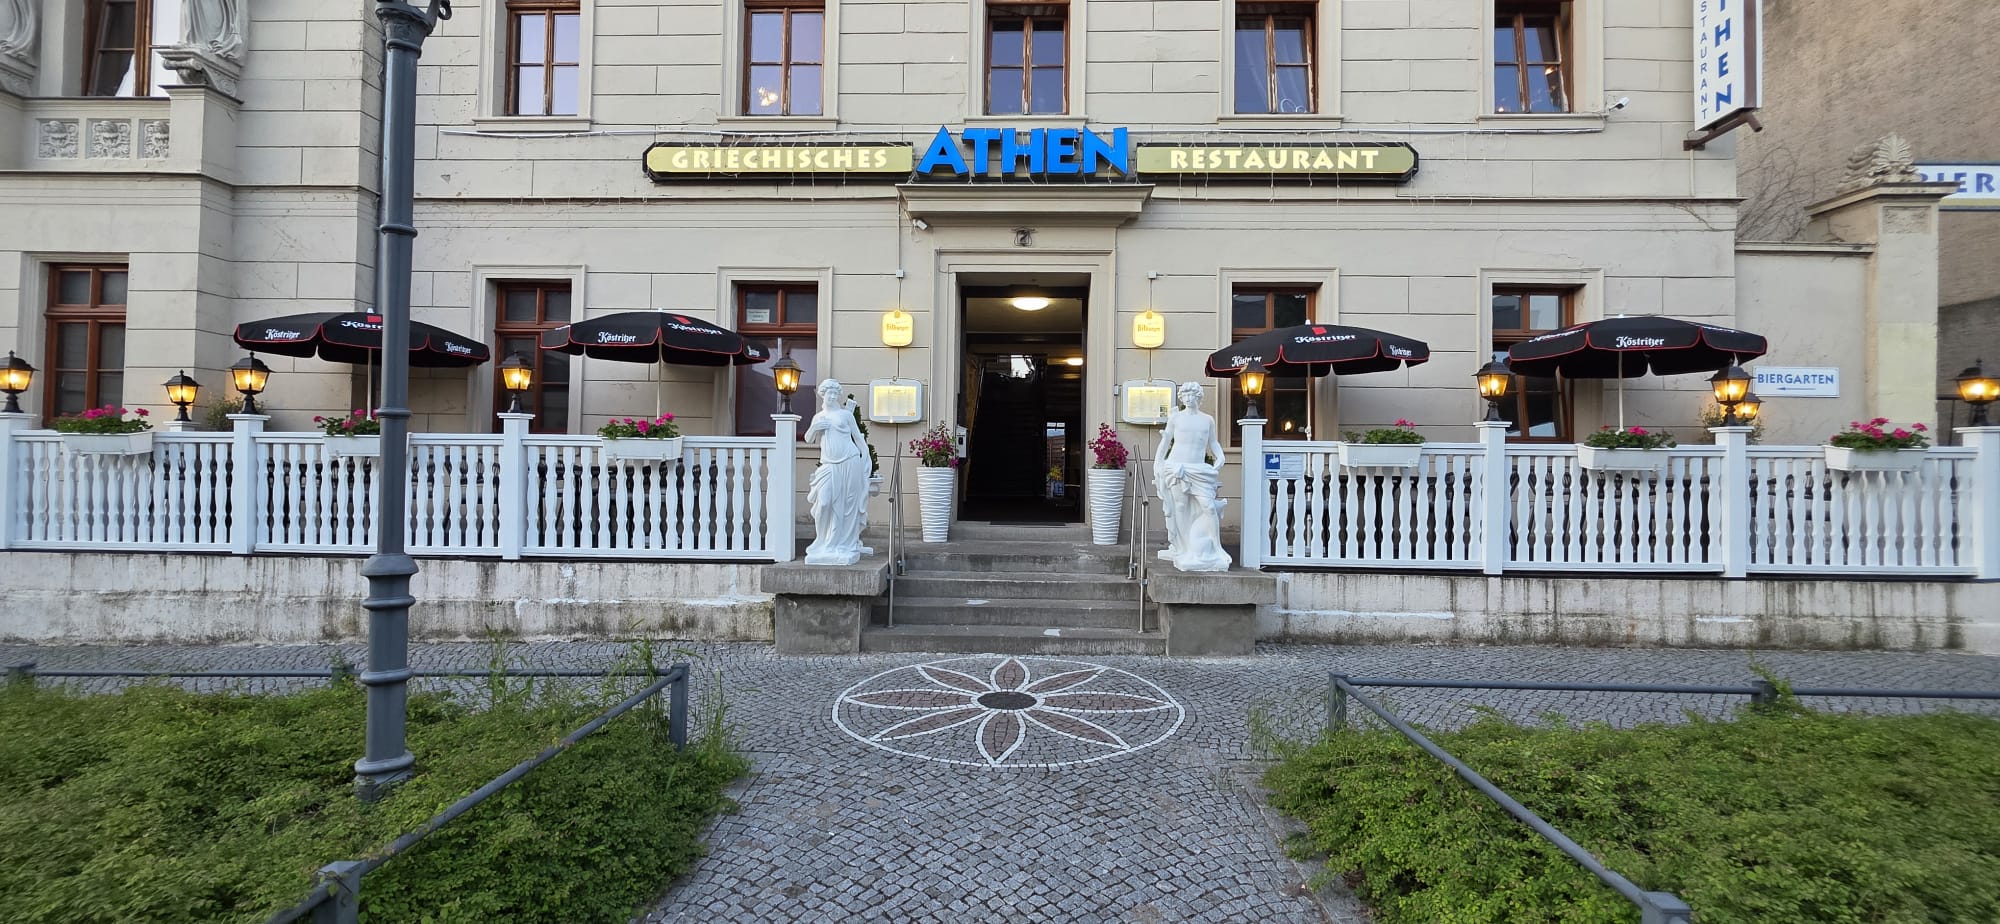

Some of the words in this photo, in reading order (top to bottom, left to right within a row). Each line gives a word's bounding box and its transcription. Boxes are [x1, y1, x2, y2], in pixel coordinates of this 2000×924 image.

[671, 148, 888, 169] GRIECHISCHES
[916, 124, 1128, 176] ATHEN
[1170, 149, 1379, 170] RESTAURANT
[597, 331, 637, 344] Köstritzer
[1615, 335, 1665, 348] Köstritzer
[1757, 373, 1835, 385] BIERGARTEN
